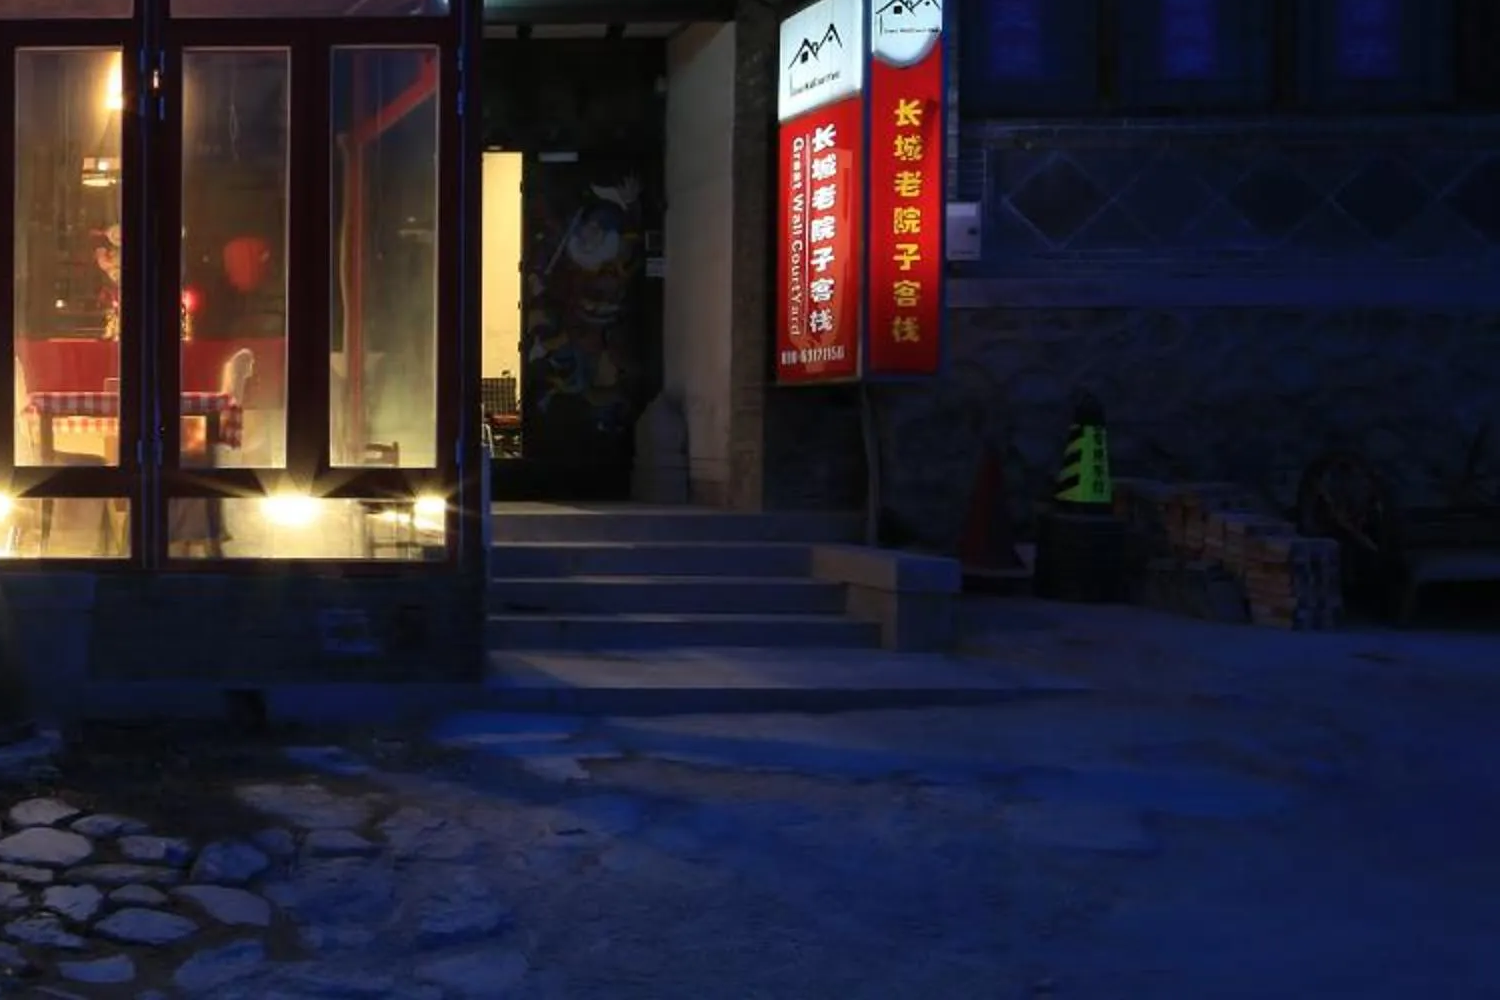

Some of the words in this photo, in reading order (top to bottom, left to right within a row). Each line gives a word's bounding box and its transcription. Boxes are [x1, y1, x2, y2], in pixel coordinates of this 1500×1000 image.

[792, 137, 805, 189] Great
[792, 193, 804, 235] Wall
[809, 123, 837, 333] 长城老院子客栈
[893, 98, 924, 342] 长城老院子客栈
